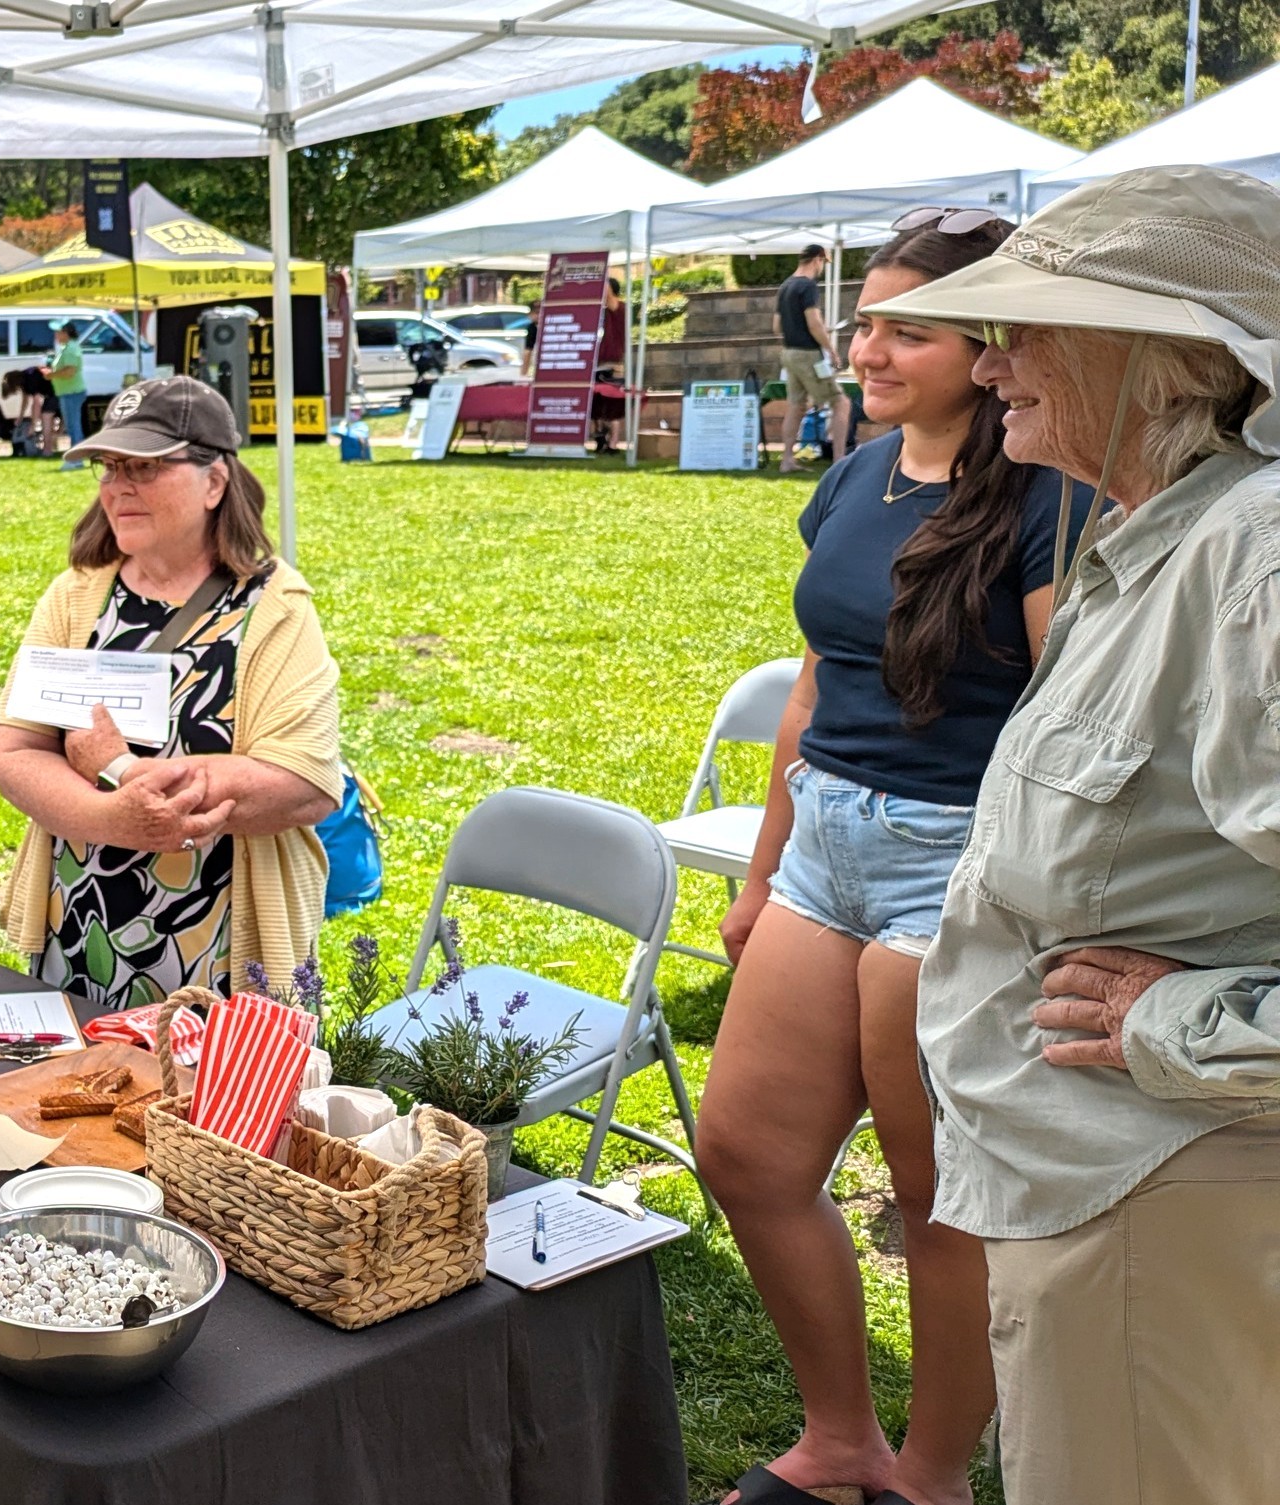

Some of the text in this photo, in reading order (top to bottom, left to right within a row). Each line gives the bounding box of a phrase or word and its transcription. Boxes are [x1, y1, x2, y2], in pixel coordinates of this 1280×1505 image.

[25, 275, 55, 294] LOCAL
[170, 270, 200, 286] YOUR
[205, 267, 241, 284] LOCAL
